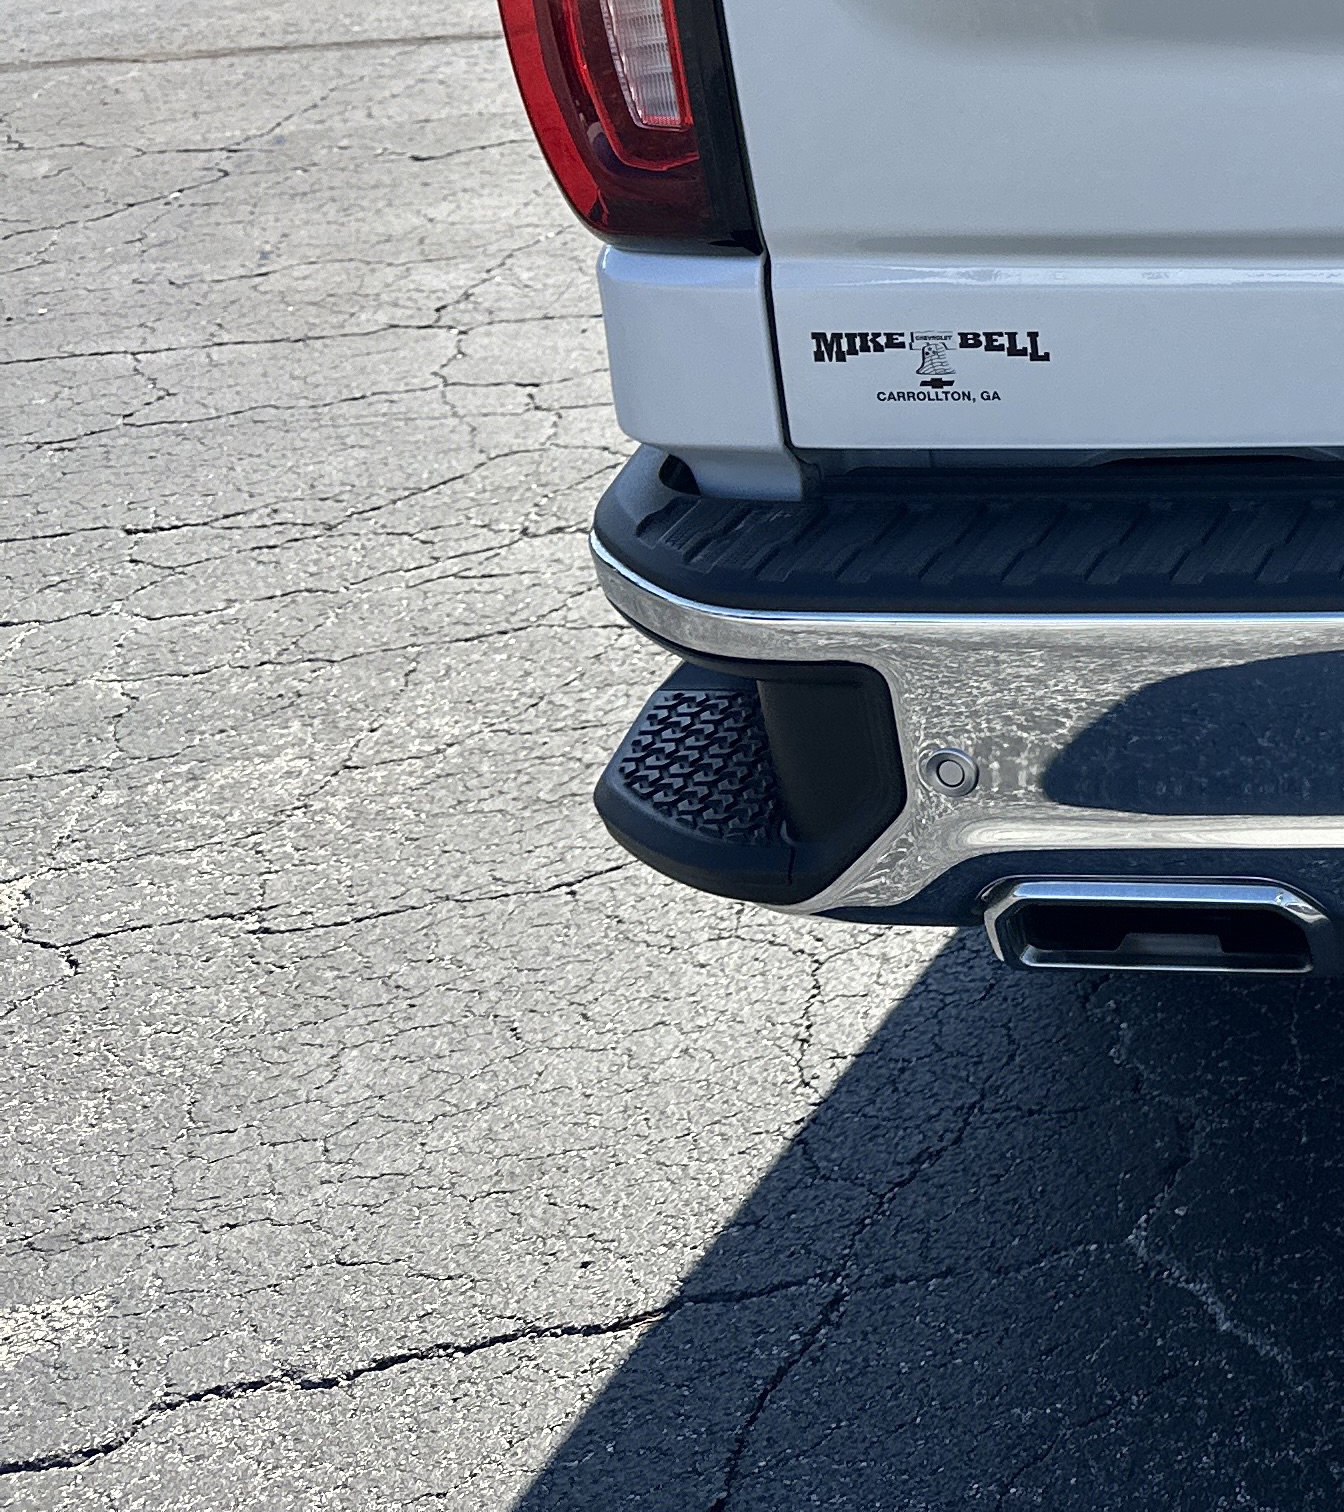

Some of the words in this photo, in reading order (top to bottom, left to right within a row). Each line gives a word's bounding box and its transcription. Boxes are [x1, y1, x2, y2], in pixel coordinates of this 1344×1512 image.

[810, 331, 906, 363] MIKE
[957, 331, 1051, 362] BELL
[876, 390, 977, 403] CARROLLTON,
[980, 391, 1001, 401] GA
